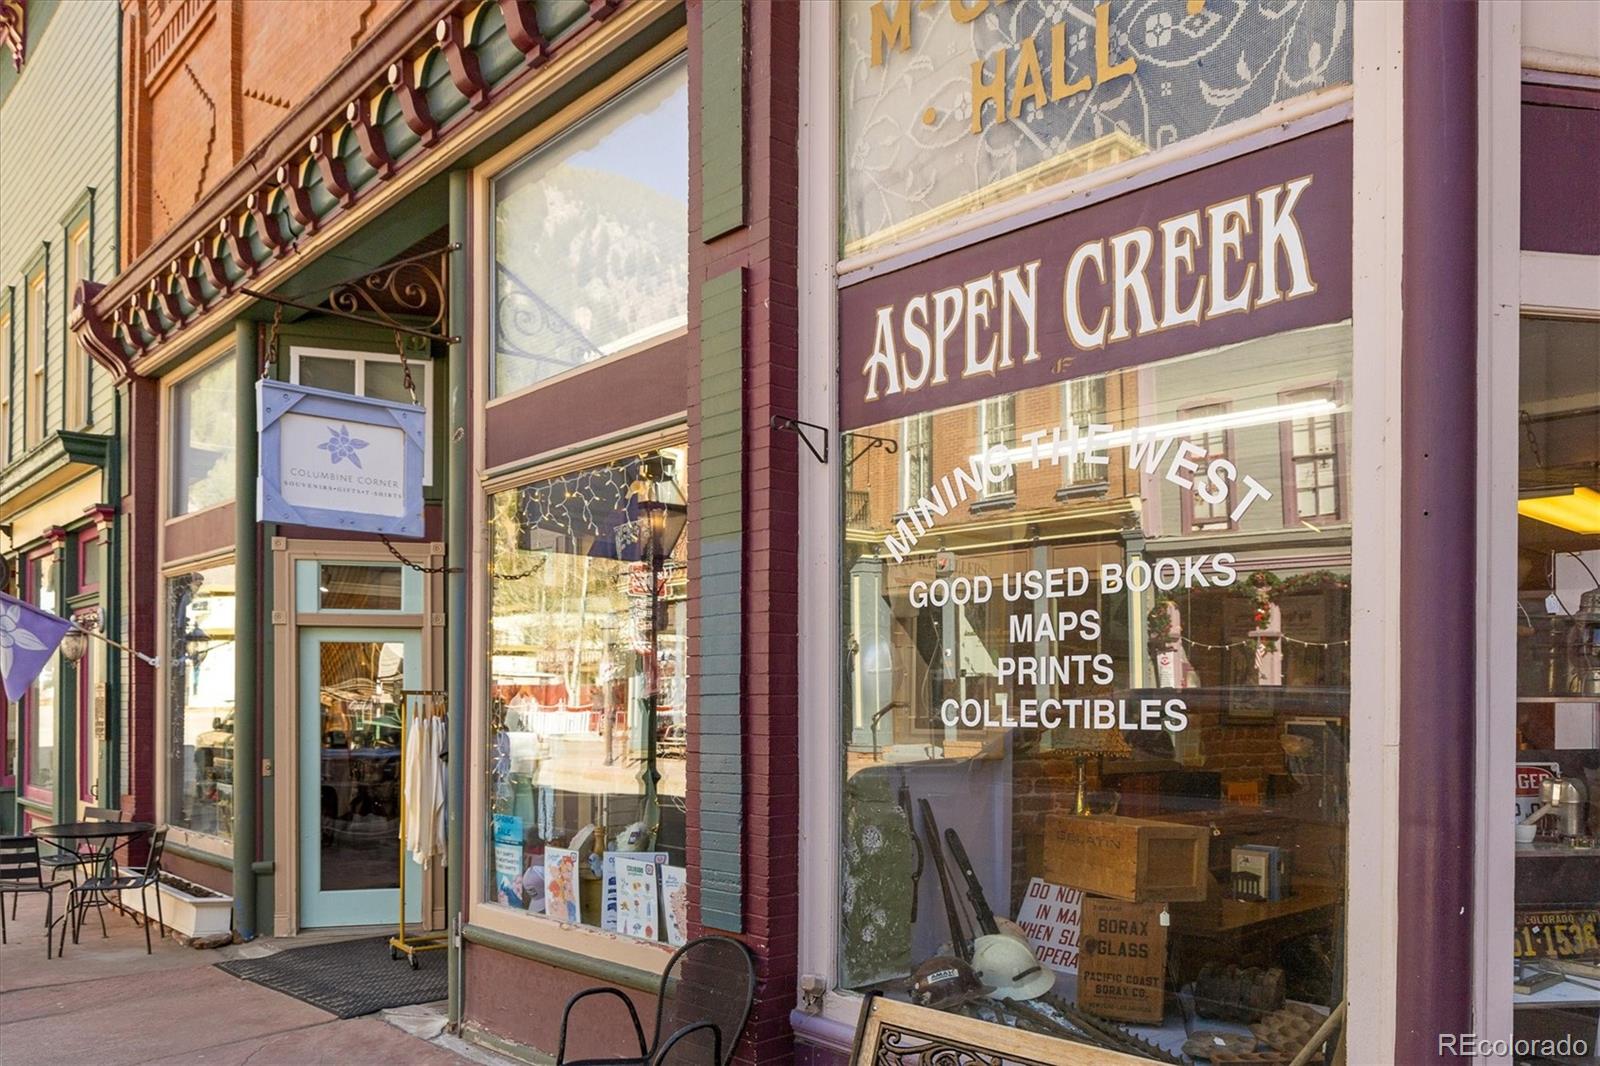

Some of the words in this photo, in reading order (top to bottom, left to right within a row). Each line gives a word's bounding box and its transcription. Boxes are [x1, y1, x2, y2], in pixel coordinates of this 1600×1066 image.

[970, 2, 1137, 134] HALL
[863, 258, 1042, 401] ASPEN
[1063, 174, 1319, 351] CREEK
[289, 467, 353, 483] COLUMBINE
[357, 476, 400, 489] CORNER
[883, 444, 1014, 564] MINING
[1022, 423, 1114, 469] THE
[1127, 427, 1273, 523] WEST
[909, 575, 993, 610] GOOD
[1002, 566, 1089, 601] USED
[1100, 552, 1237, 595] BOOKS
[1008, 609, 1101, 643] MAPS
[997, 654, 1114, 686] PRINTS
[940, 698, 1189, 732] COLLECTIBLES
[1029, 882, 1050, 900] DO
[1035, 903, 1052, 920] IN
[1524, 914, 1574, 925] COLORADO
[1018, 920, 1055, 942] WHEN
[1098, 918, 1149, 937] BORAX
[1097, 940, 1149, 959] GLASS
[1083, 970, 1122, 982] PACIFIC
[1126, 975, 1160, 987] COAST
[1095, 984, 1129, 997] BORAX
